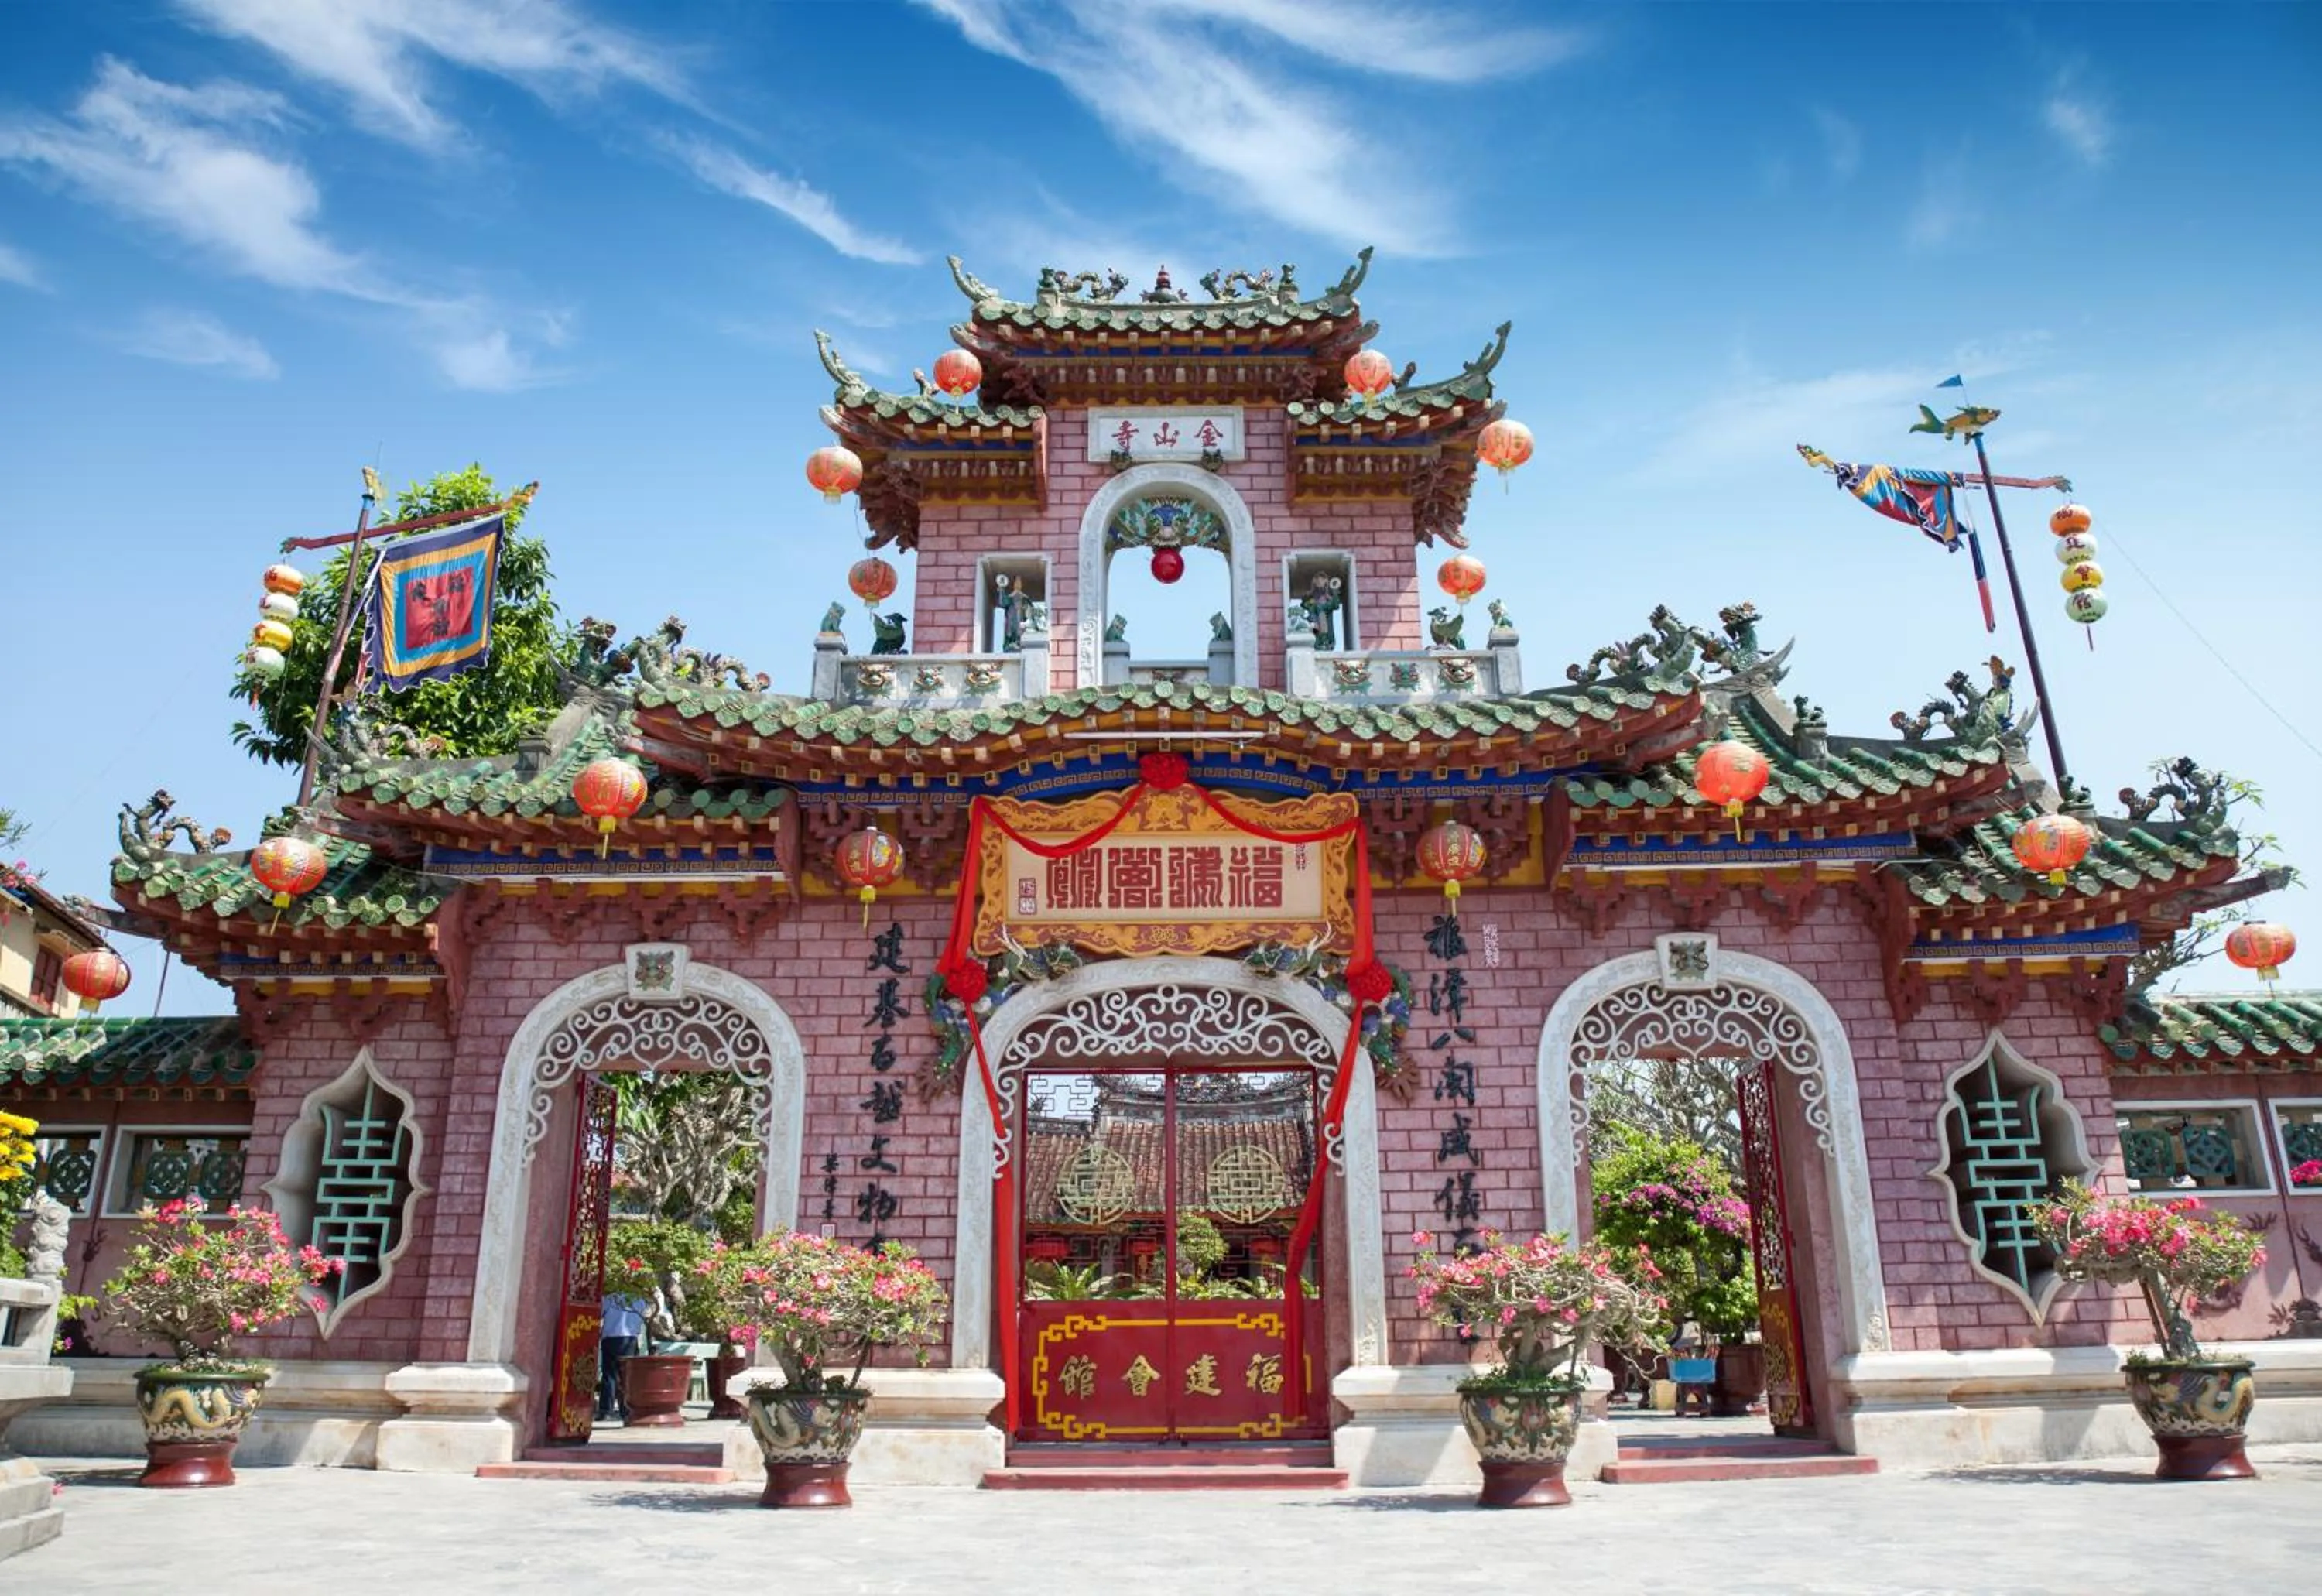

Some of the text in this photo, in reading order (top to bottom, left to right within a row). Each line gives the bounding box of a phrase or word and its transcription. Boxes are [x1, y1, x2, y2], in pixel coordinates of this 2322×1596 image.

[1111, 419, 1224, 451] 金山寺
[1058, 1352, 1284, 1399] 福建會館
